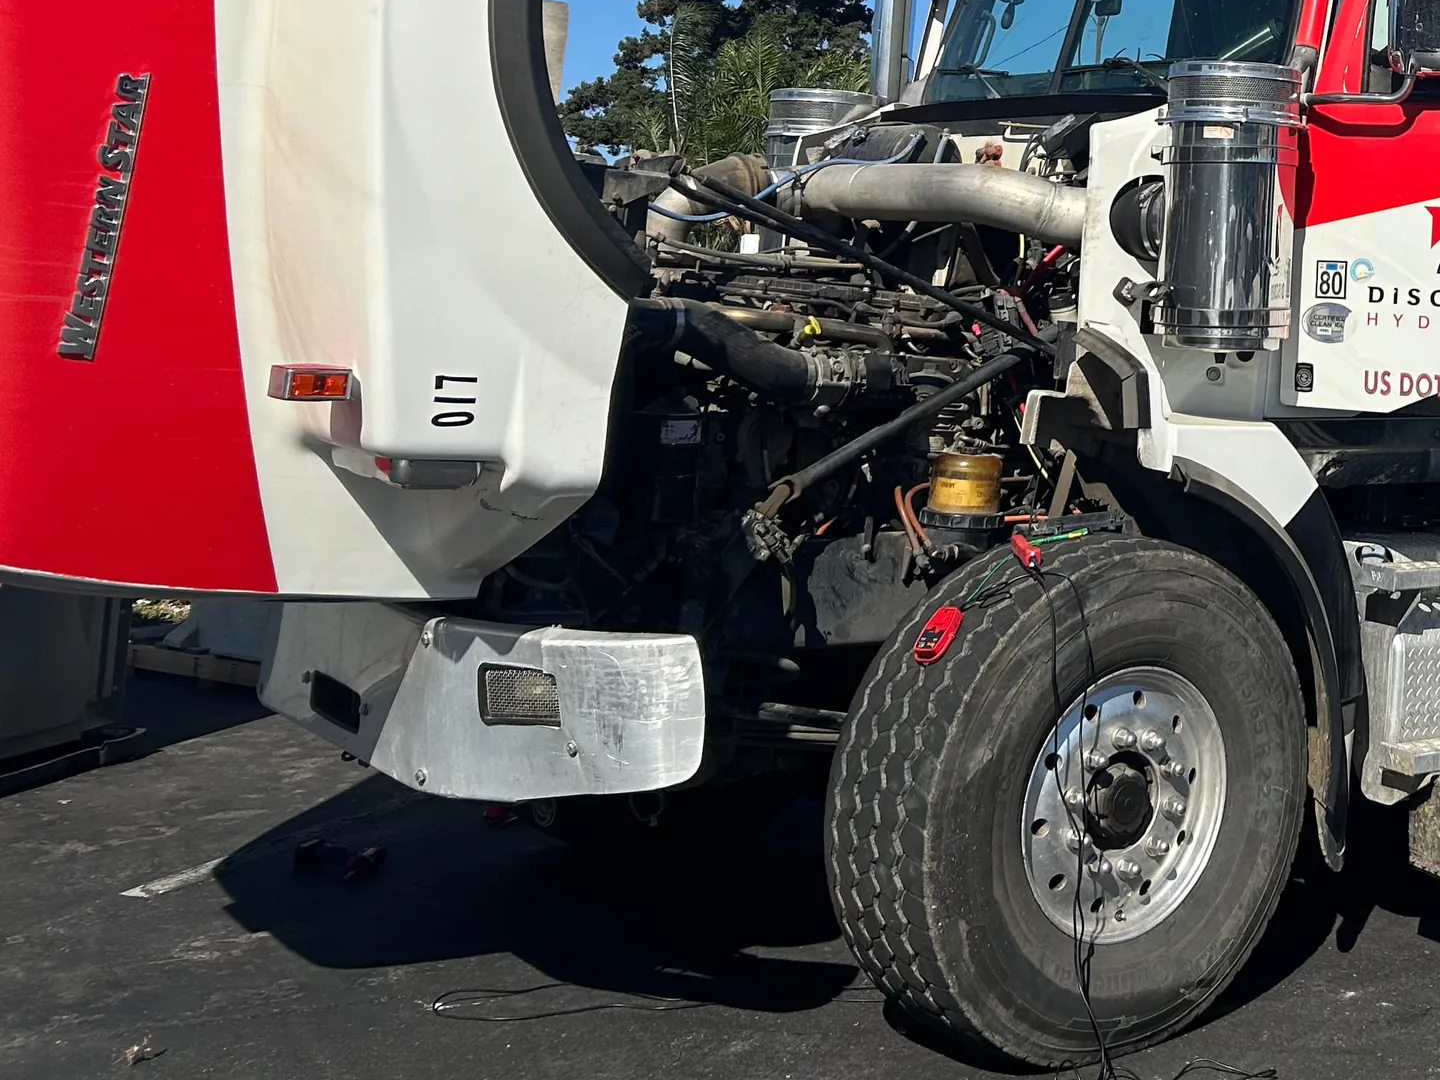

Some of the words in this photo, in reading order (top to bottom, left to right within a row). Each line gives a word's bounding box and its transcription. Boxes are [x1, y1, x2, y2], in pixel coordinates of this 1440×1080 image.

[57, 175, 126, 360] WESTERN
[98, 72, 150, 174] STAR
[1319, 270, 1343, 296] 80
[430, 375, 478, 427] 017
[1364, 370, 1392, 396] US
